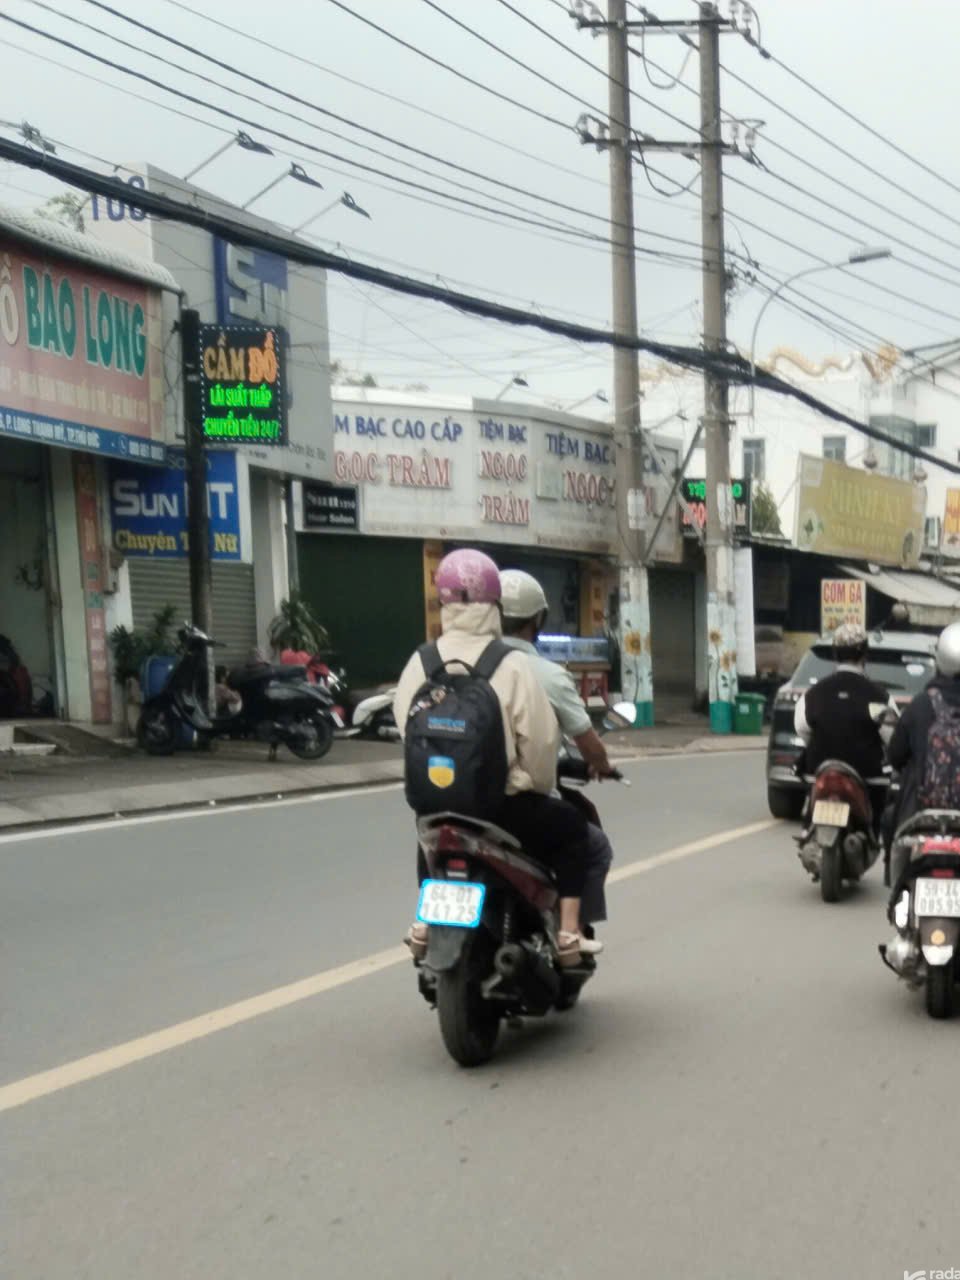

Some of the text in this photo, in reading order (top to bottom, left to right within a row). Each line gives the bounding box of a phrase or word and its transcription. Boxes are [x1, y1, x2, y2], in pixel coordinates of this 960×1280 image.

[82, 283, 148, 380] LONG
[355, 415, 386, 440] BẠC
[392, 417, 425, 439] CAO
[431, 415, 463, 441] CẤP
